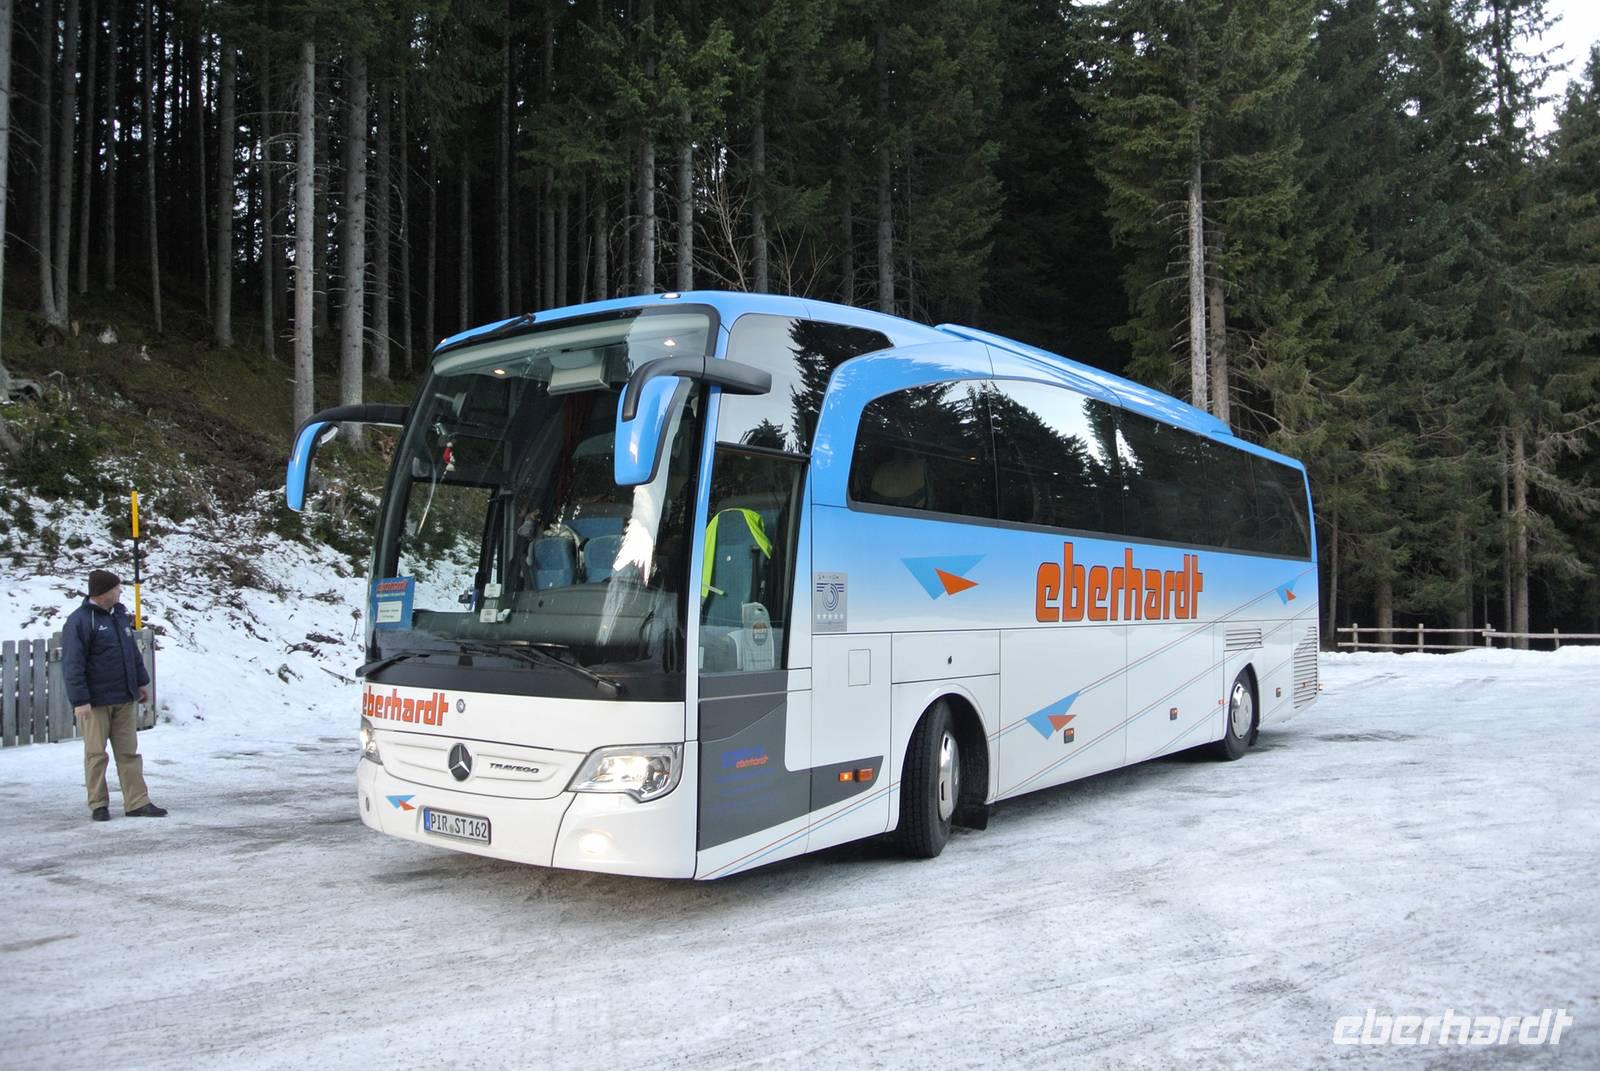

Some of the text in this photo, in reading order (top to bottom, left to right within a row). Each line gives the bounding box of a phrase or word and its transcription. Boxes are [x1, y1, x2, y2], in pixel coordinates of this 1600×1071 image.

[1035, 541, 1203, 622] eberhardt
[490, 762, 540, 774] TRAVEGO
[430, 813, 487, 839] PIR ST 162
